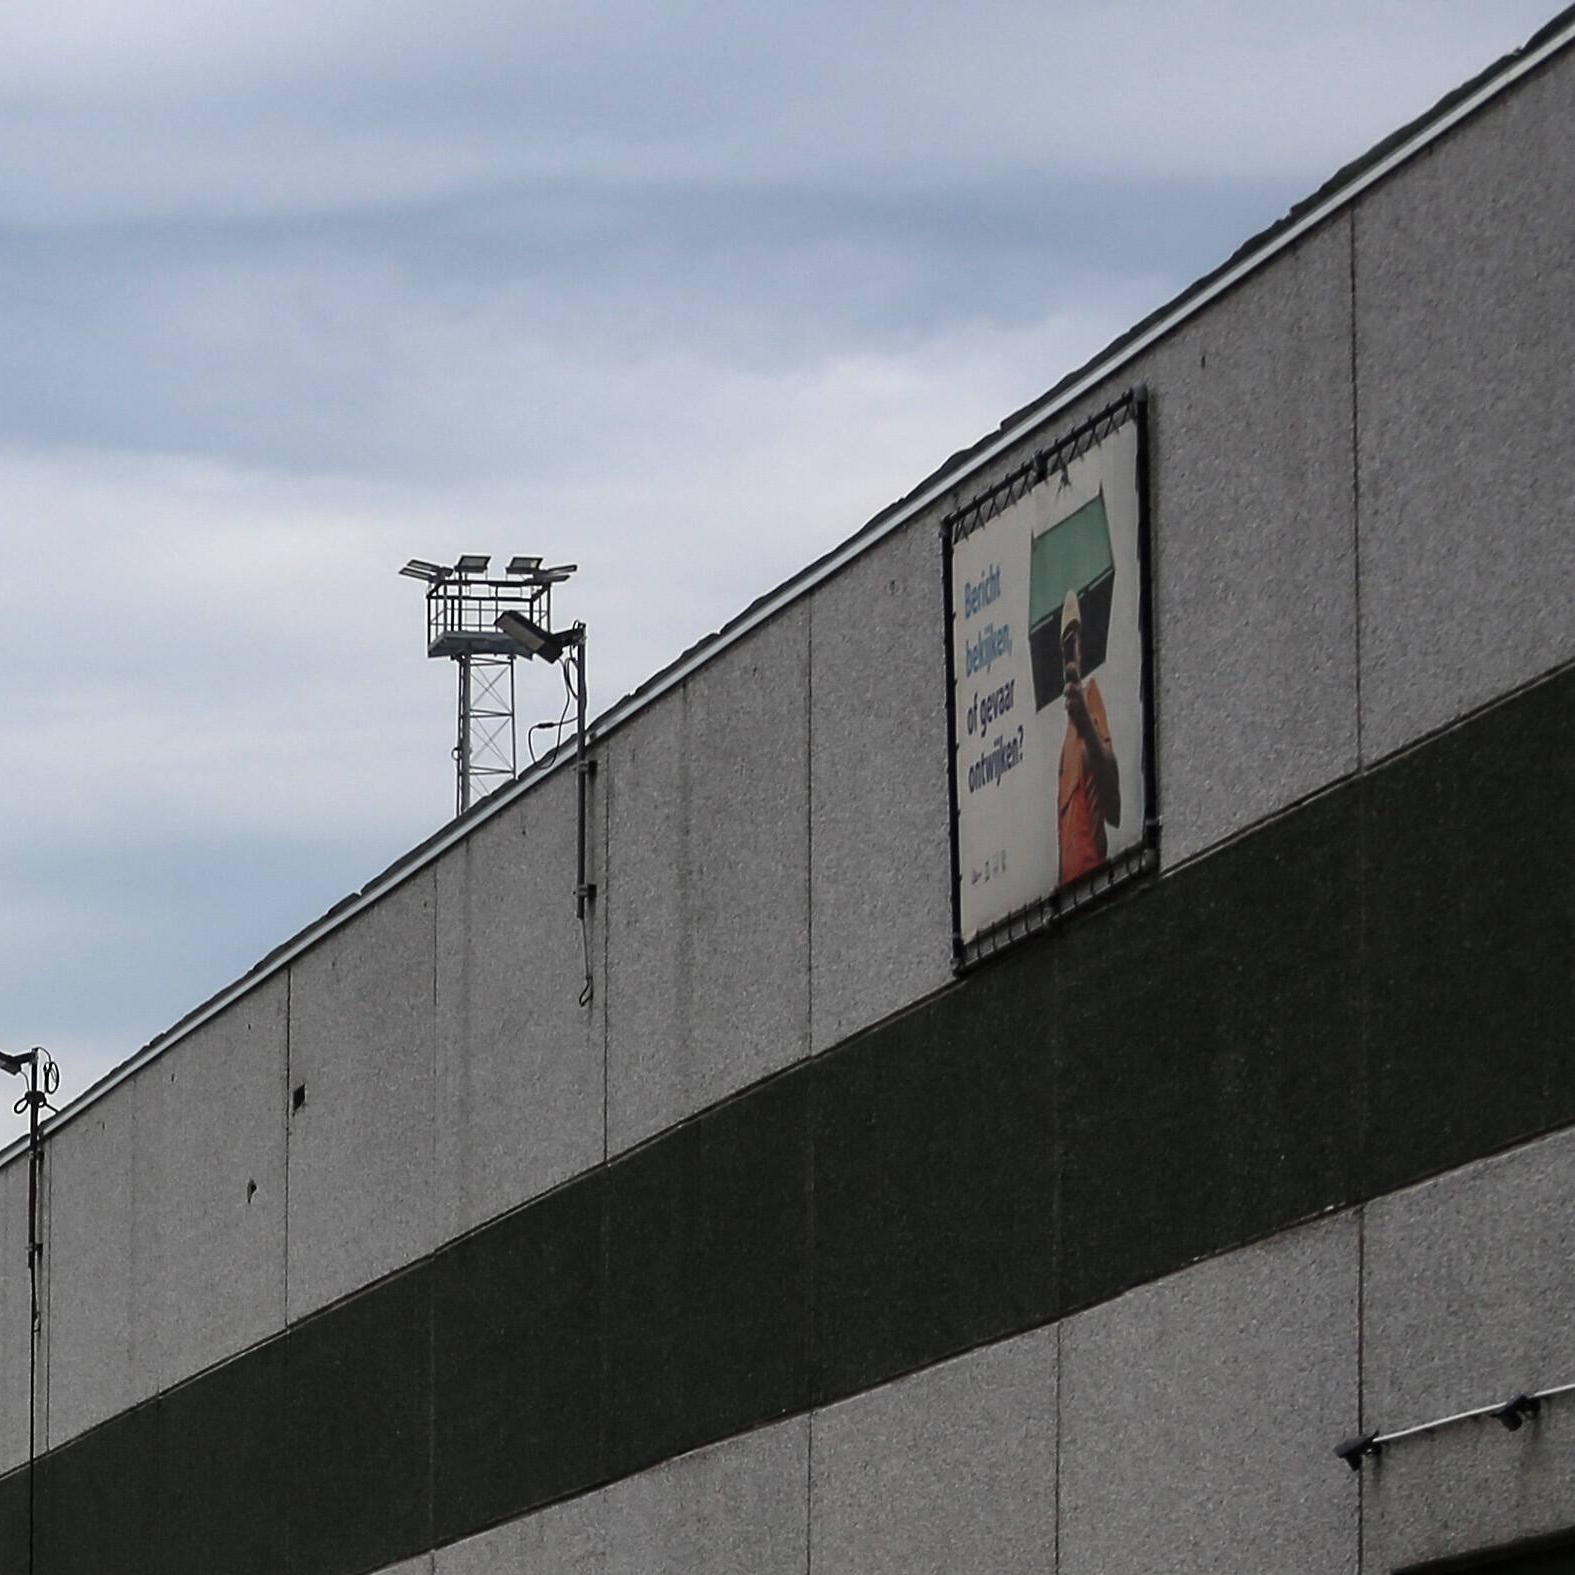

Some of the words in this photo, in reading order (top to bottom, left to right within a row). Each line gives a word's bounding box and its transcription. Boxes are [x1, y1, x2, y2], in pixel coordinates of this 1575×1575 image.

[967, 692, 978, 736] of
[980, 678, 1015, 738] gevaar
[968, 724, 1024, 793] ontwijken?
